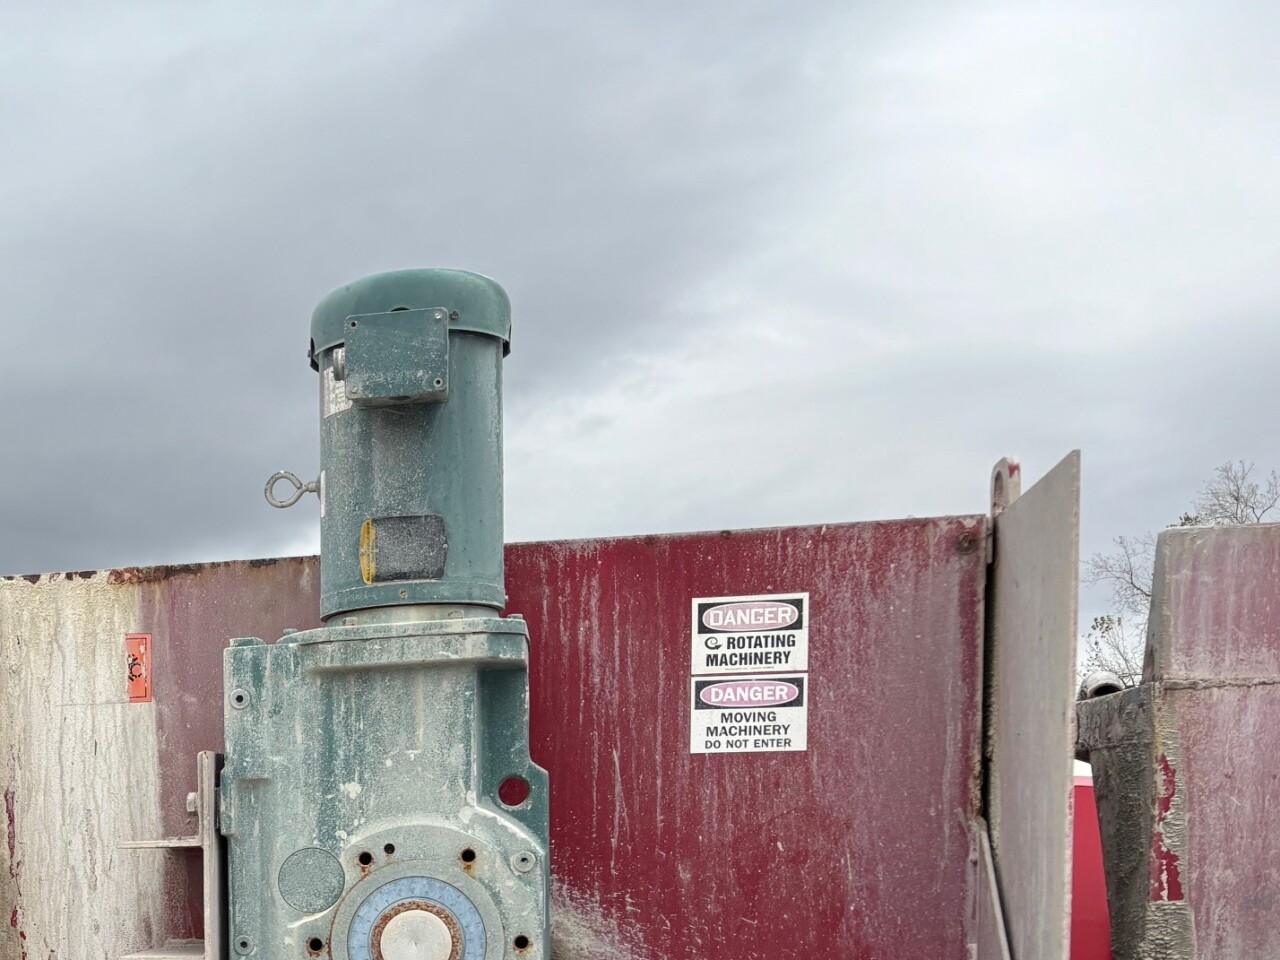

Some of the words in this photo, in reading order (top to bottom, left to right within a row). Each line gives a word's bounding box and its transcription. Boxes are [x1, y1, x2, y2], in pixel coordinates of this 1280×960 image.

[709, 607, 792, 626] DANGER
[726, 634, 796, 650] ROTATING
[705, 651, 791, 667] MACHINERY
[710, 685, 789, 702] DANGER
[720, 711, 777, 723] MOVING
[706, 724, 791, 737] MACHINERY
[704, 740, 721, 749] DO
[726, 739, 749, 749] NOT
[753, 738, 792, 748] ENTER
